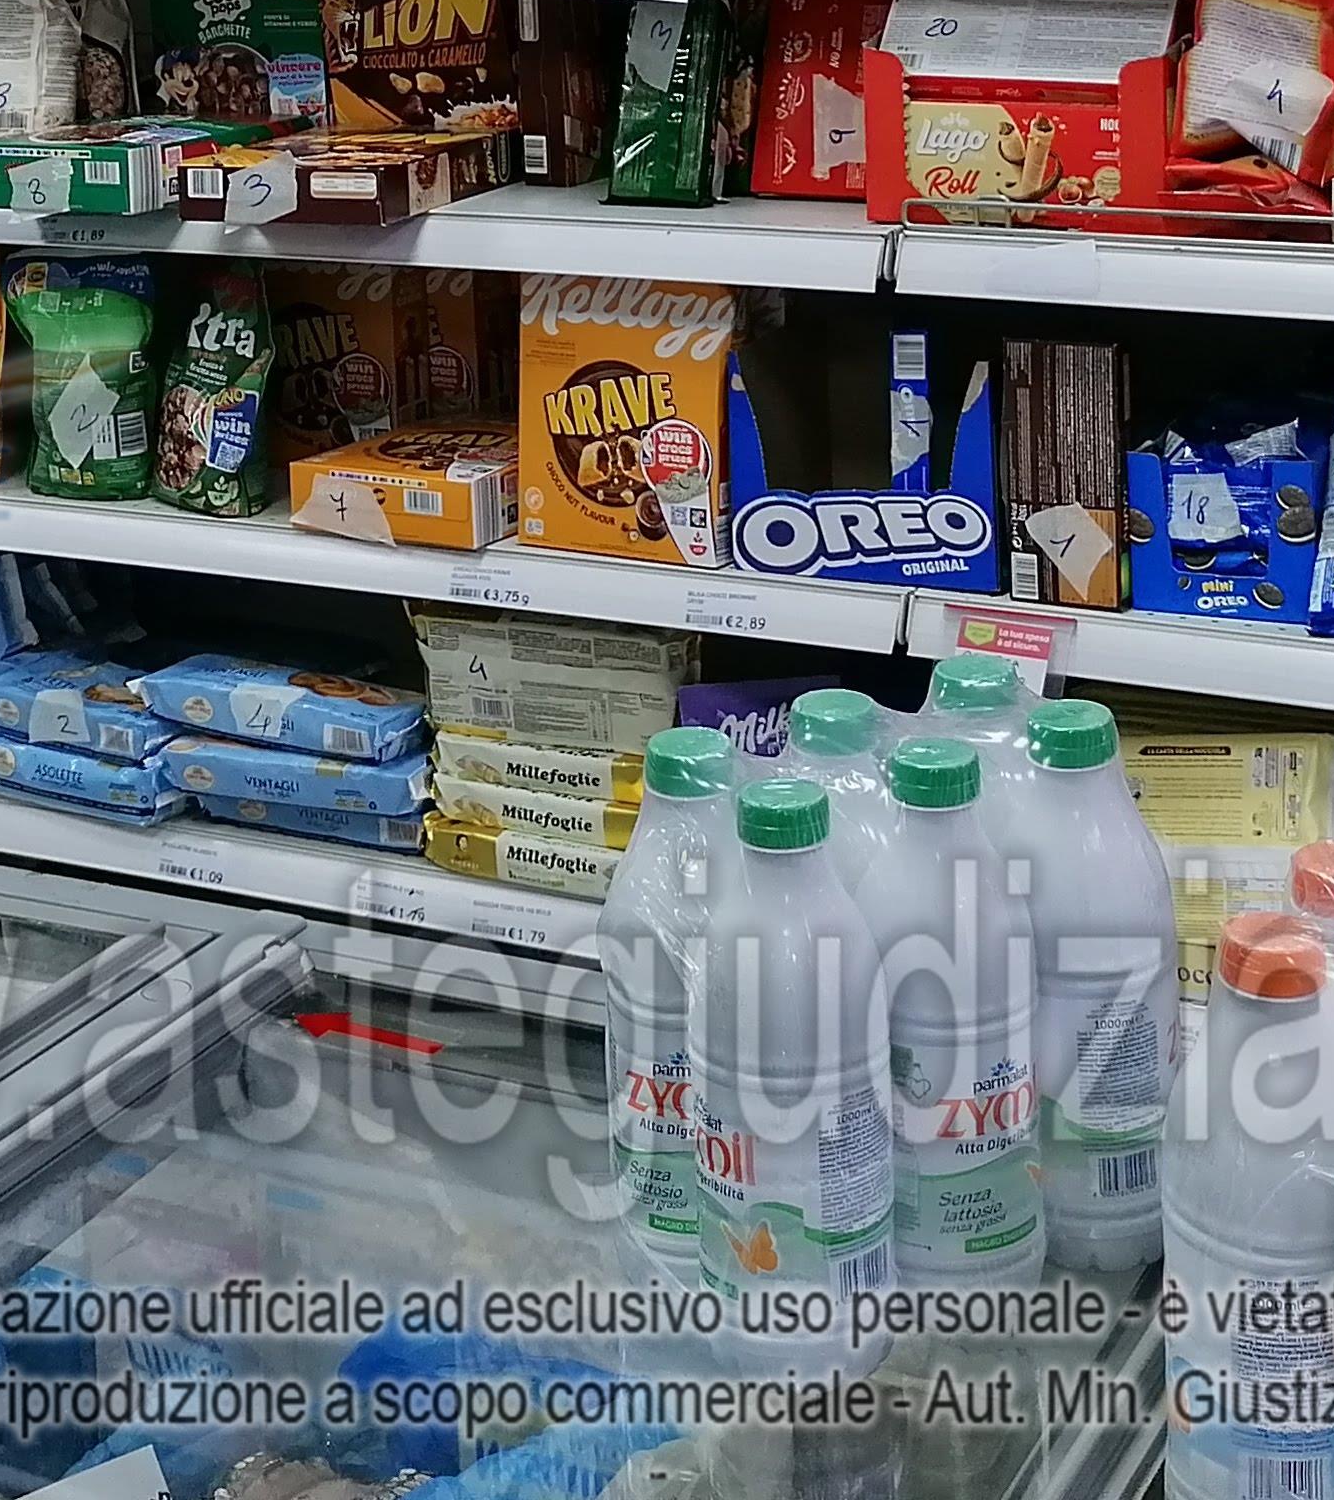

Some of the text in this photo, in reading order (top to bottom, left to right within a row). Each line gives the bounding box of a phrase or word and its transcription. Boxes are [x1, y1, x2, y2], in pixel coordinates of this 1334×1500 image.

[428, 42, 486, 66] CARAMELLO
[915, 117, 989, 157] Lago
[925, 165, 978, 199] Roll
[543, 373, 677, 437] KRAVE
[741, 501, 985, 568] OREO
[901, 559, 969, 576] ORIGINAL
[505, 761, 601, 789] Millefoglie
[501, 803, 594, 834] Millefoglie
[938, 1187, 992, 1208] Senza
